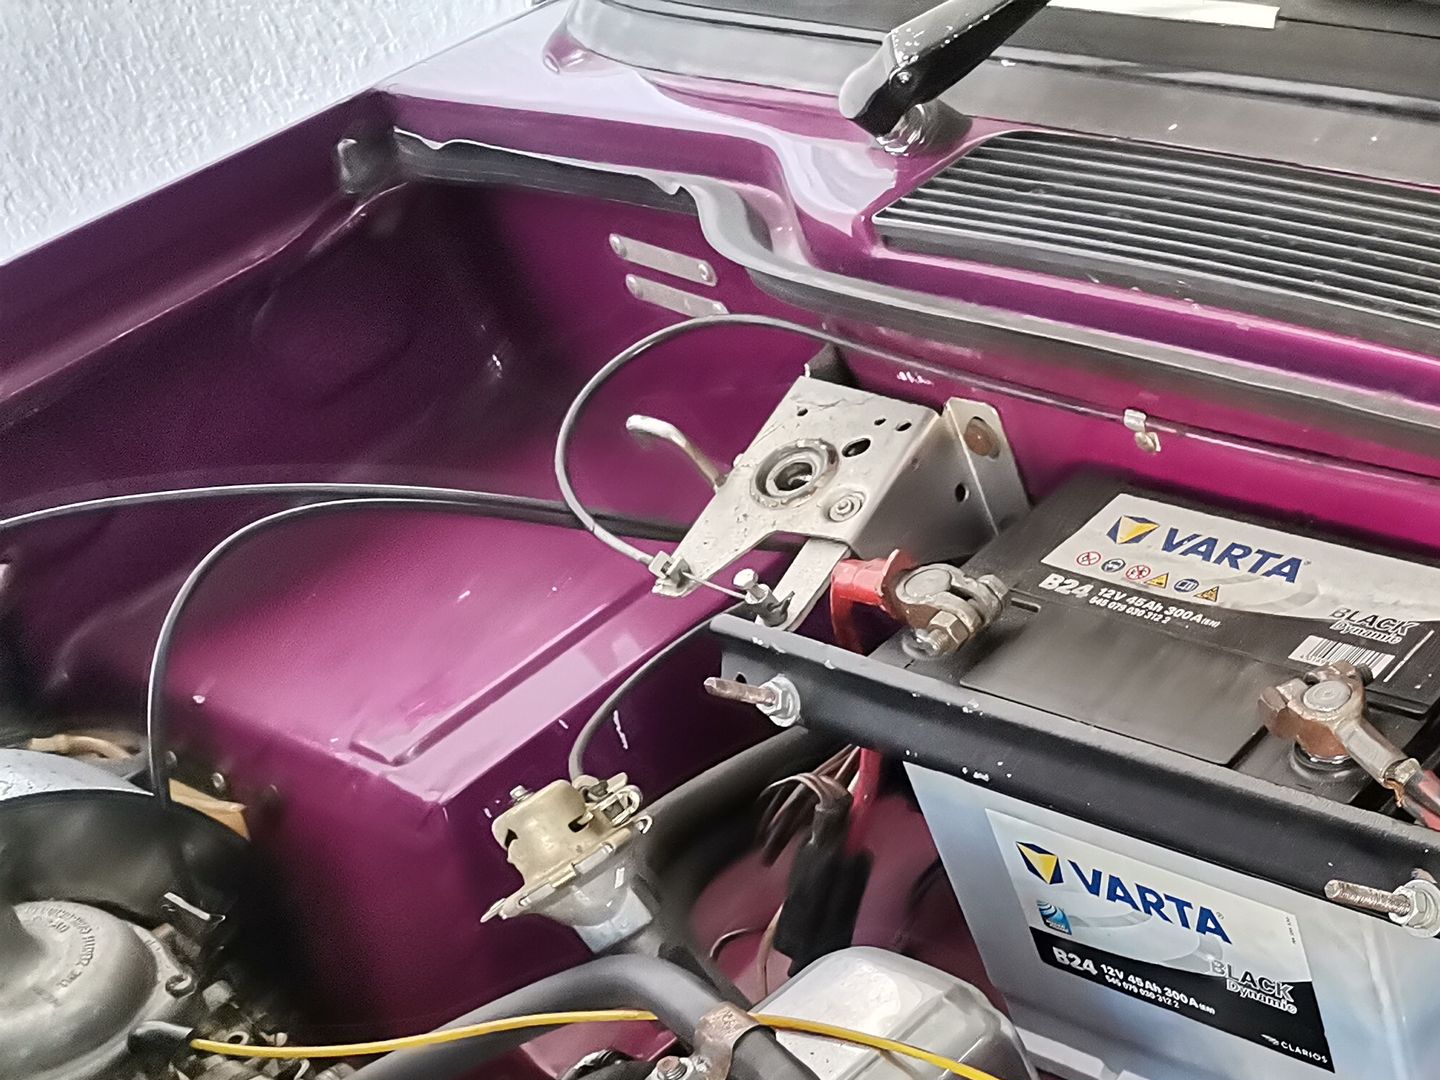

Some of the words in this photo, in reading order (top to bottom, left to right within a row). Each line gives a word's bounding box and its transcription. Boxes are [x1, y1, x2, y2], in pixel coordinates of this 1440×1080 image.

[1161, 527, 1304, 584] VARTA
[1038, 573, 1094, 598] B24
[1098, 588, 1127, 601] 12V
[1329, 607, 1420, 637] BLACK
[1068, 859, 1232, 944] VARTA
[1052, 946, 1098, 975] B24
[1100, 964, 1124, 979] 12V
[1210, 960, 1295, 1003] BLACK
[1281, 1041, 1327, 1063] CLARIOS
